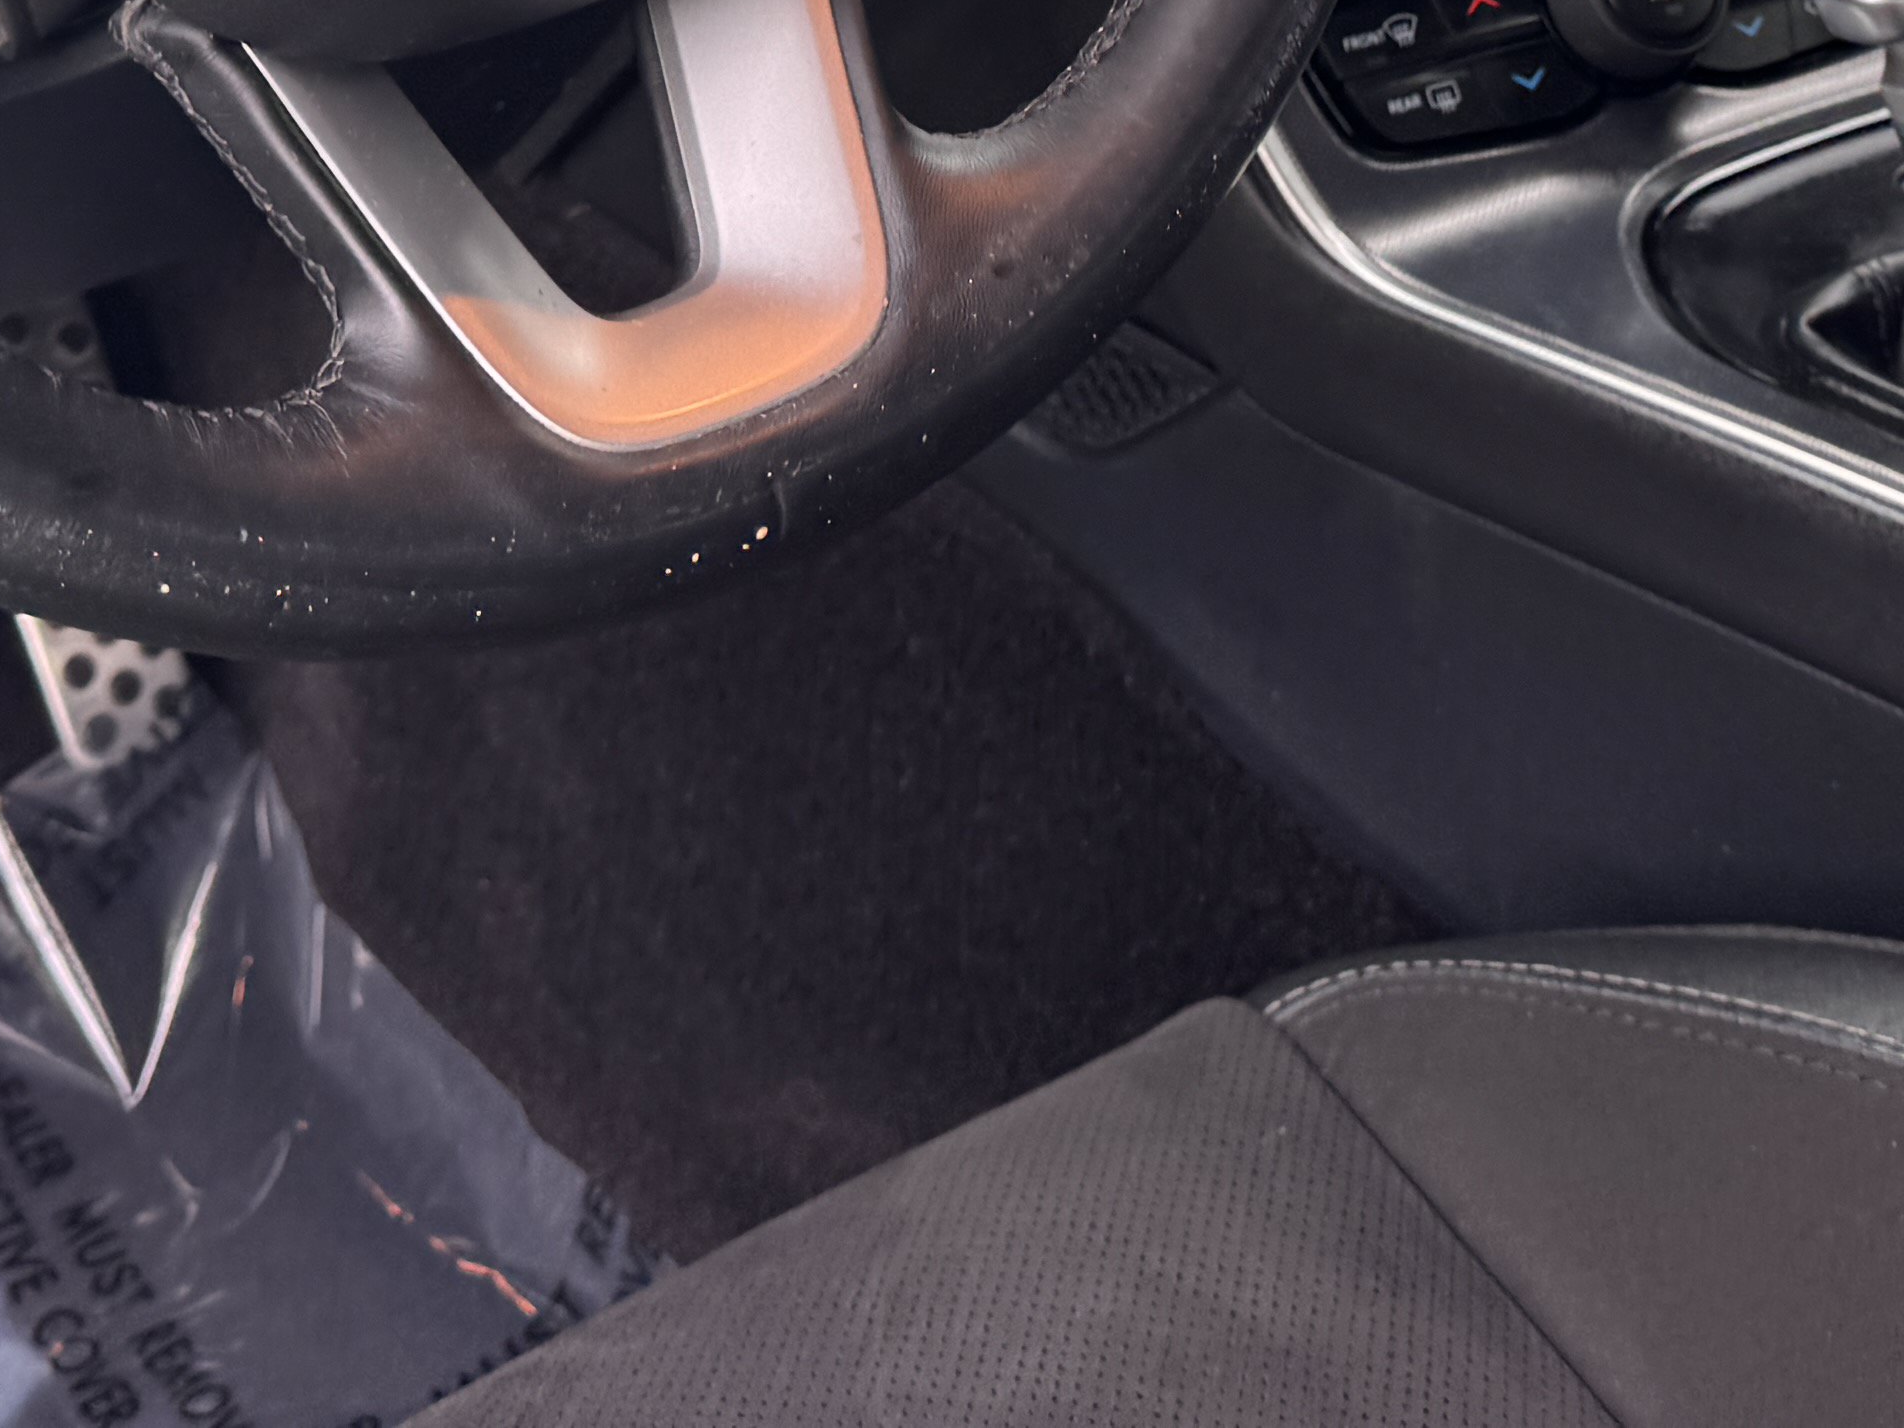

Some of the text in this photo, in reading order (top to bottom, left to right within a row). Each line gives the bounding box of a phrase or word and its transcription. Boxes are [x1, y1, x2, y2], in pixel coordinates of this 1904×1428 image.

[1342, 28, 1387, 52] FRONT
[1387, 93, 1423, 115] REAR
[53, 1197, 156, 1306] MUST
[32, 1307, 142, 1428] COVER
